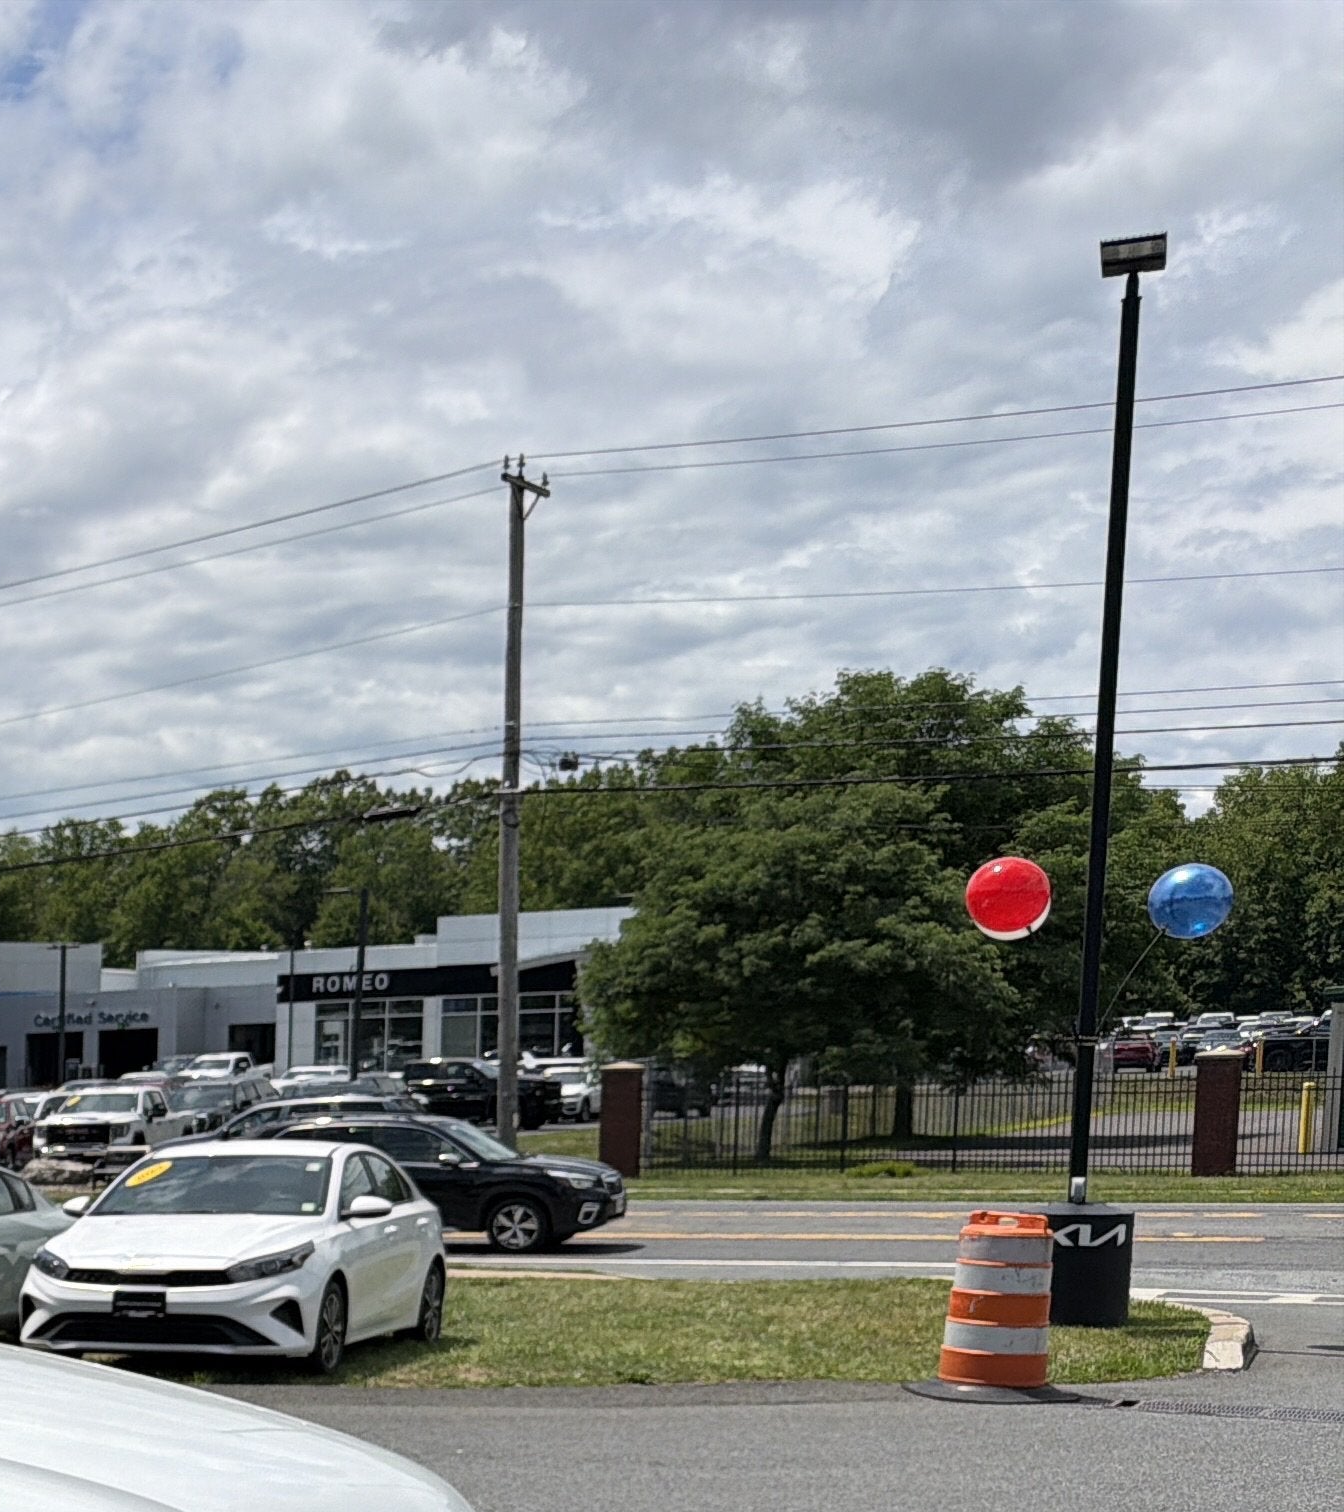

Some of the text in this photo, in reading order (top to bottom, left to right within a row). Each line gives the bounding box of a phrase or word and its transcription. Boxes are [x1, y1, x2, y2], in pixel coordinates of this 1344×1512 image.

[312, 972, 389, 994] ROMEO
[34, 1010, 150, 1028] Cerfied Service
[1053, 1223, 1127, 1247] KIA
